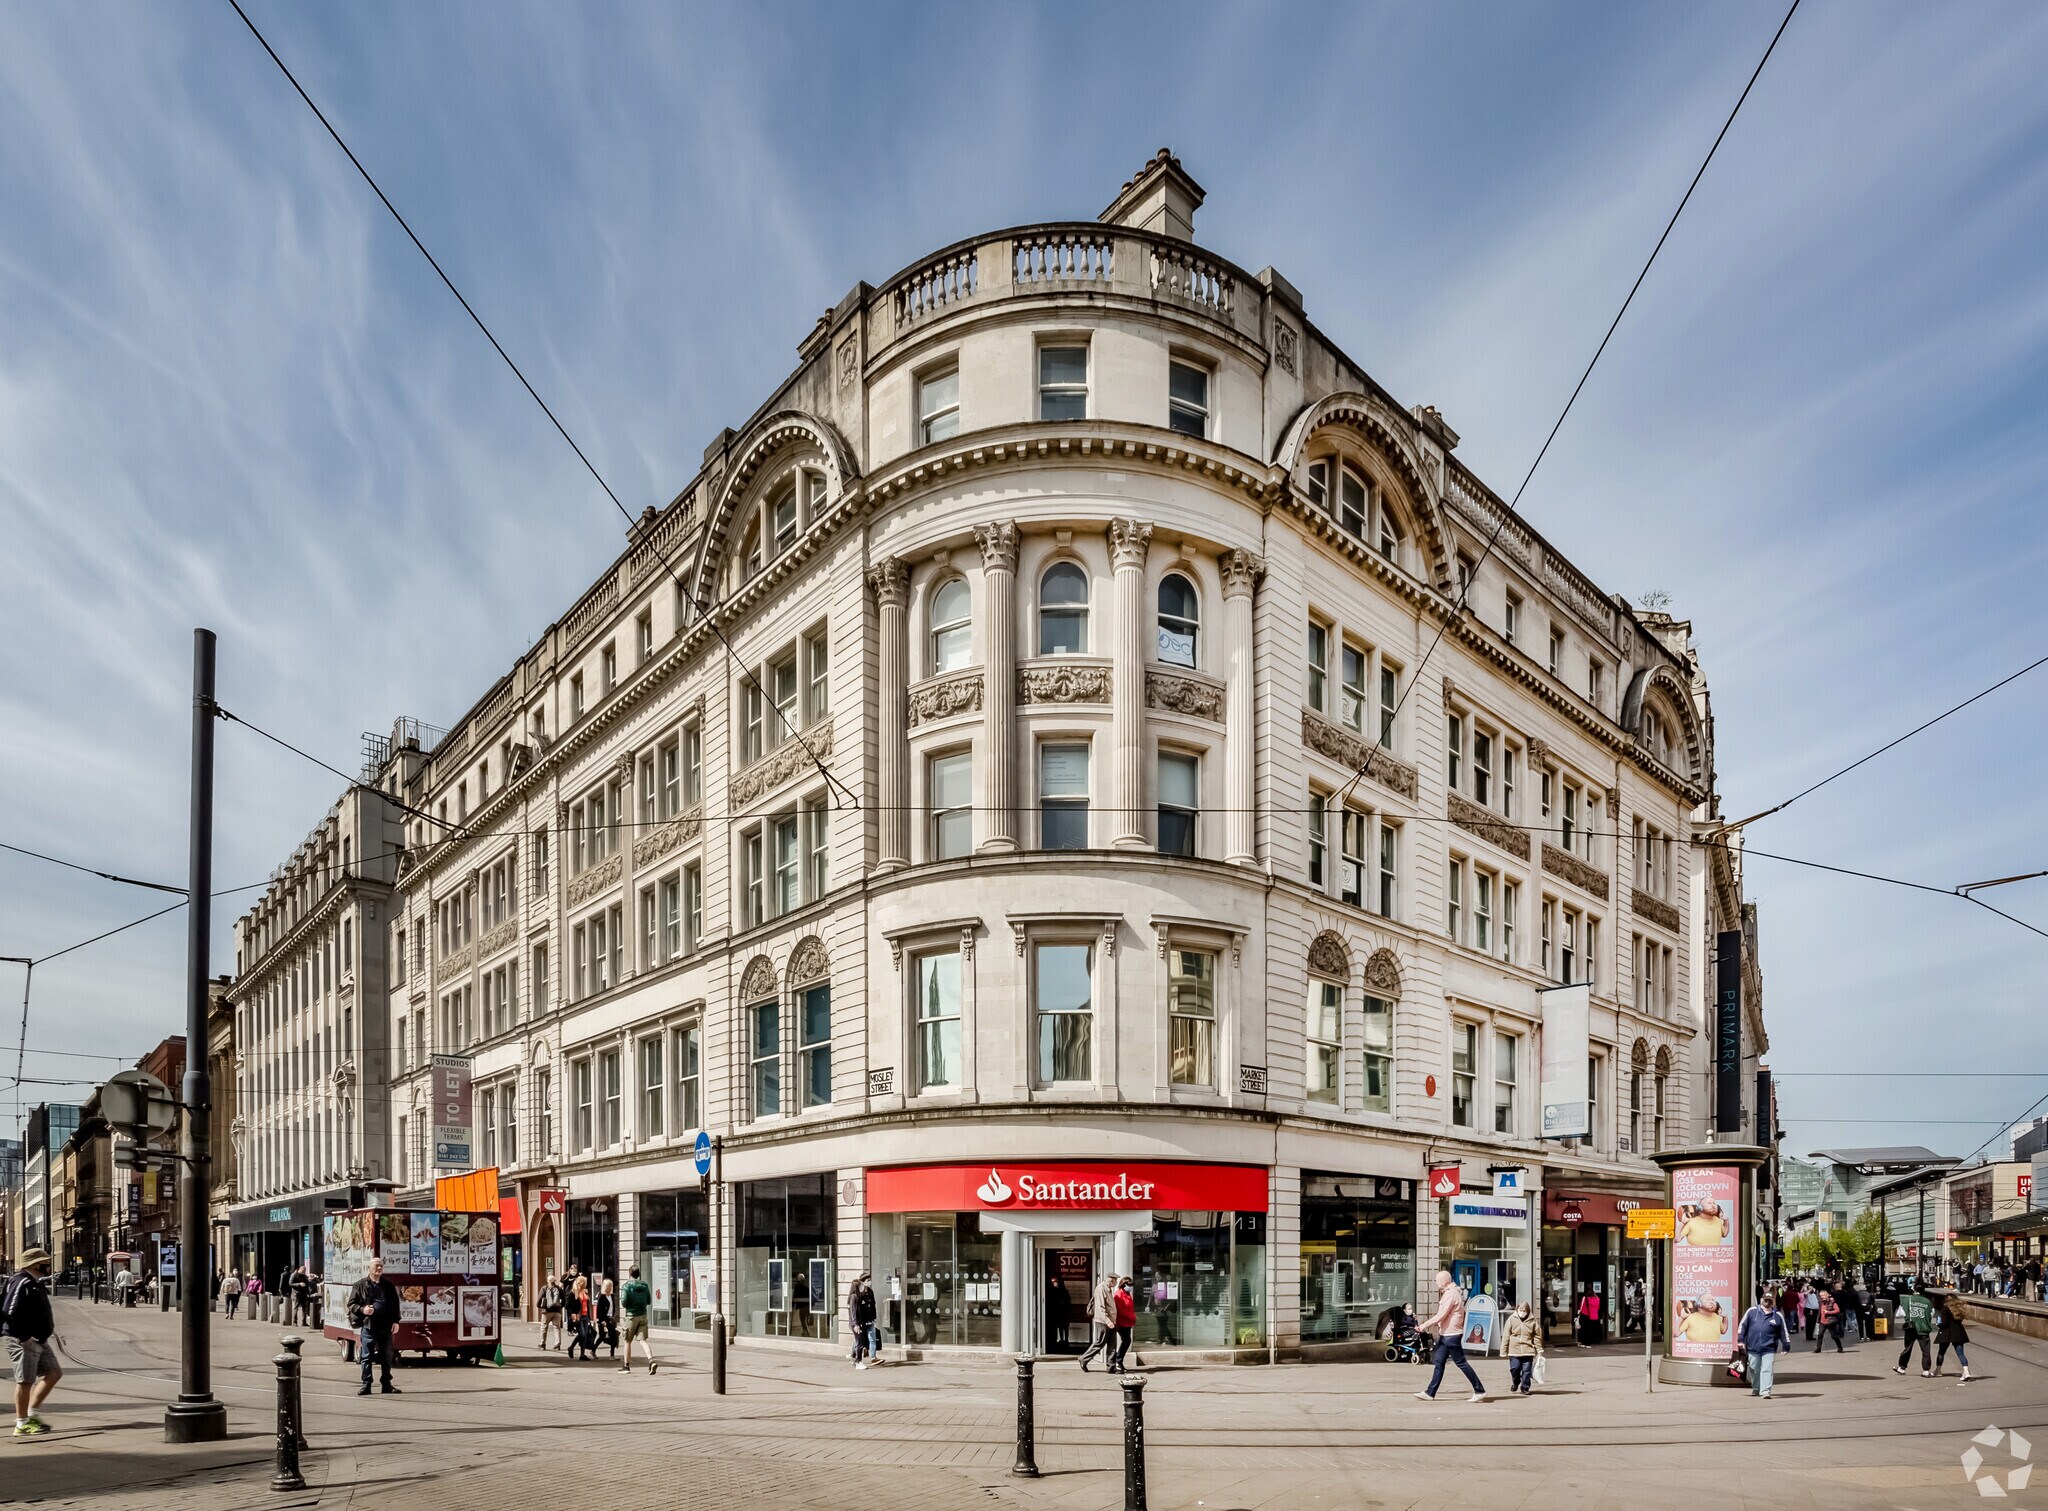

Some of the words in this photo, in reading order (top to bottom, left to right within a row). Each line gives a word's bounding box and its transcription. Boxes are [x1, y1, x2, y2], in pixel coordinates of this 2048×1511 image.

[1723, 990, 1736, 1073] PRIMARK
[435, 1057, 470, 1068] STUDIOS
[870, 1071, 894, 1083] MOSLEY
[1240, 1068, 1266, 1081] MARKET
[446, 1070, 460, 1098] LET
[870, 1081, 893, 1094] STREET
[1241, 1079, 1265, 1091] STREET
[446, 1102, 460, 1123] TO
[440, 1127, 465, 1135] FLEXIBLE
[1759, 1105, 1768, 1148] PRIMAR
[443, 1133, 463, 1141] TERMS
[1675, 1170, 1686, 1178] SO
[1693, 1169, 1713, 1177] CAN
[1018, 1172, 1155, 1201] Santander
[1676, 1177, 1695, 1185] LOSE
[1676, 1183, 1729, 1192] LOCKDOWN
[1676, 1191, 1712, 1199] POUNDS
[1060, 1255, 1087, 1266] STOP
[1675, 1279, 1728, 1287] LOCKDOWN
[1675, 1286, 1711, 1294] POUNDS
[1911, 1307, 1925, 1319] 53
